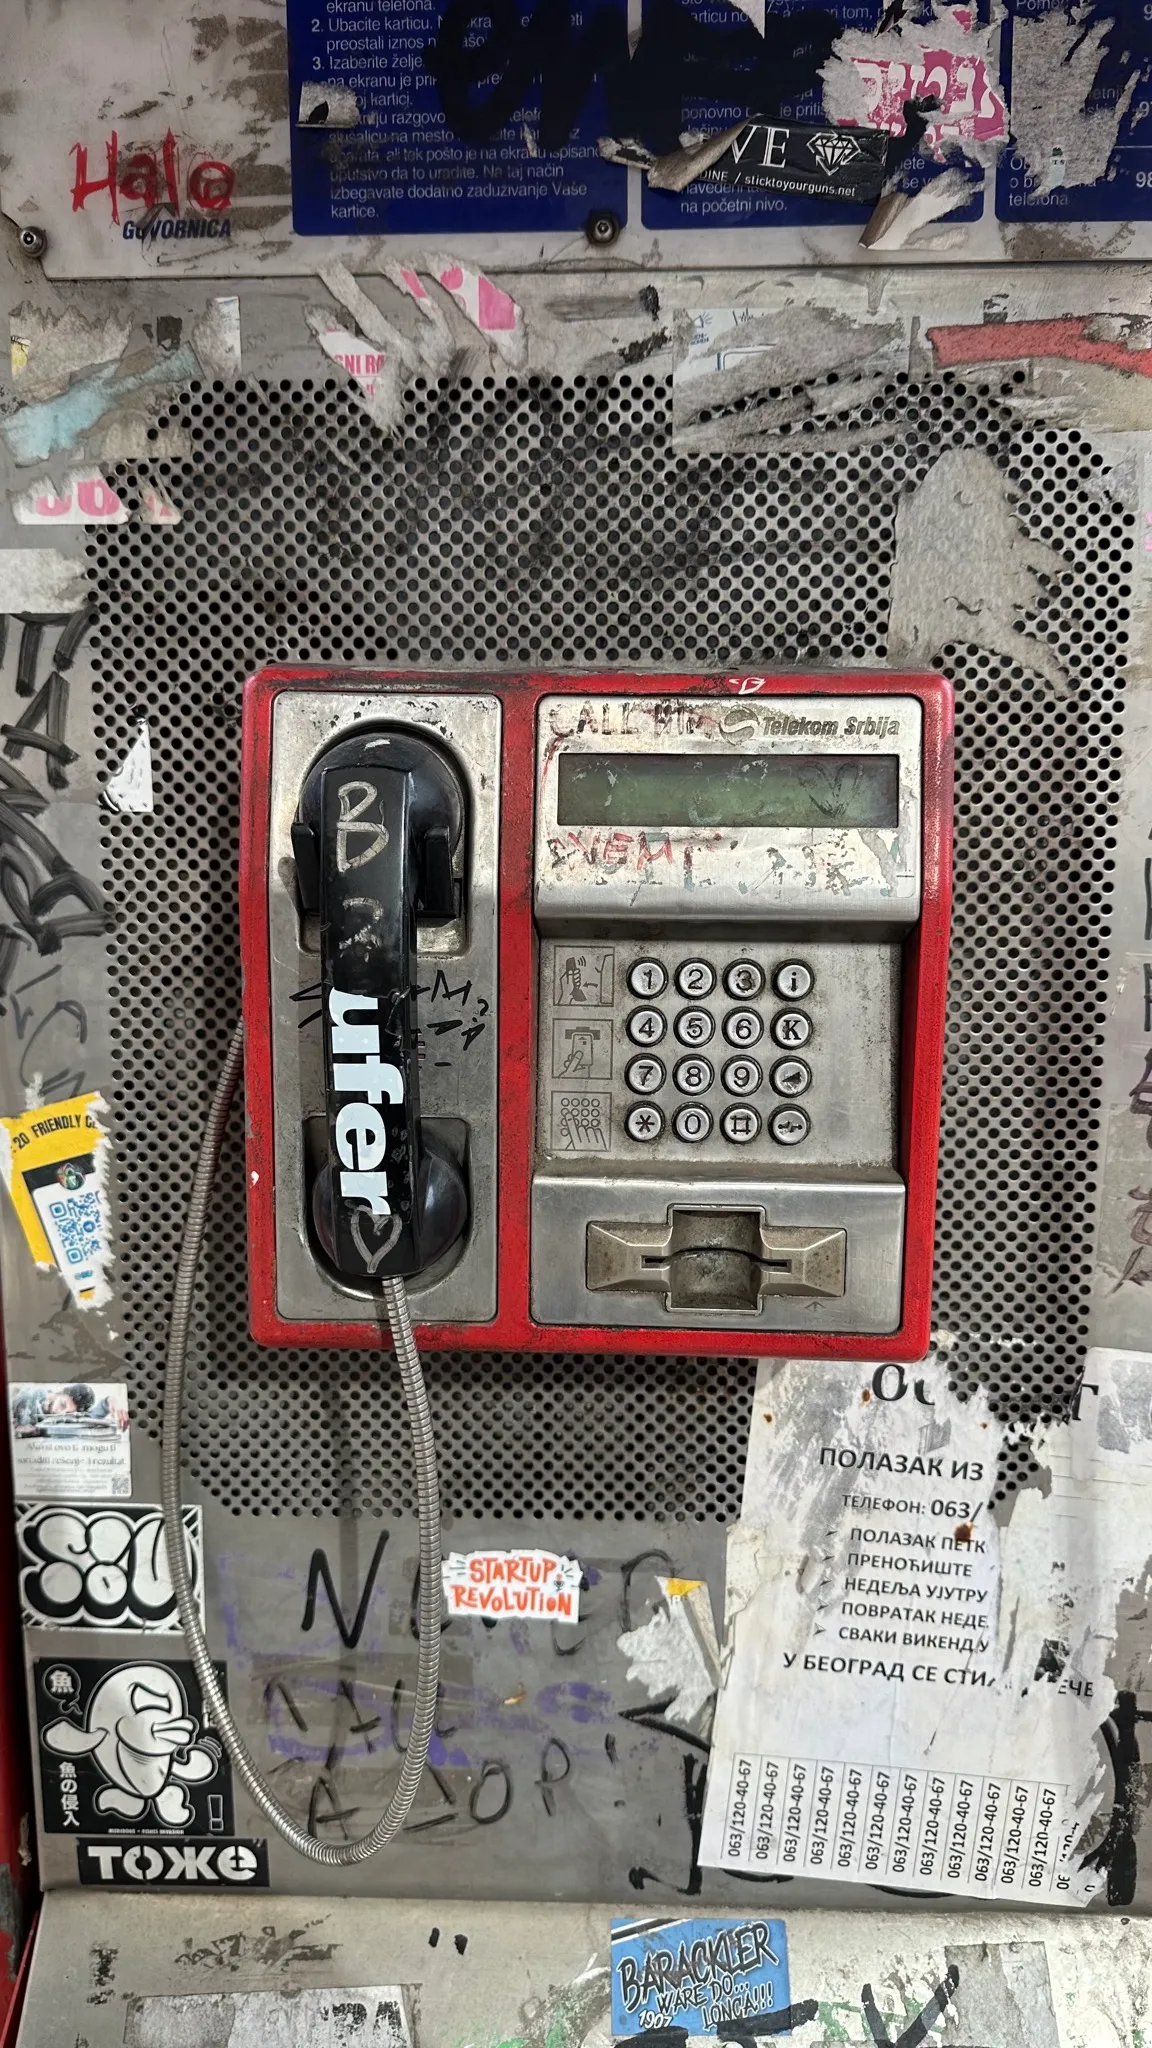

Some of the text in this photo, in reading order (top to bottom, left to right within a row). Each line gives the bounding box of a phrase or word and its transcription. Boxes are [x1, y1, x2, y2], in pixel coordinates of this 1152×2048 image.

[326, 0, 374, 13] ekranu
[311, 18, 324, 33] 2.
[328, 17, 381, 32] Ubacite
[326, 35, 384, 54] preostali
[388, 34, 424, 50] iznos
[312, 56, 325, 71] 3.
[329, 54, 388, 70] Izaberite
[348, 73, 397, 89] ekranu
[399, 72, 412, 91] je
[681, 107, 742, 123] ponovno
[779, 104, 792, 119] je
[412, 128, 455, 144] mesto
[403, 147, 423, 161] tek
[426, 146, 463, 164] pošto
[465, 146, 477, 163] je
[480, 148, 497, 160] na
[391, 166, 409, 181] da
[412, 167, 426, 181] to
[483, 164, 503, 179] Na
[507, 165, 523, 181] taj
[526, 163, 564, 179] način
[330, 184, 404, 202] izbegavate
[407, 183, 464, 199] dodatno
[551, 180, 588, 196] Vaše
[744, 176, 856, 197] sticktoyourguns.net
[331, 203, 379, 219] kartice.
[681, 196, 788, 217] na početni nivo.
[763, 716, 901, 739] Telekom Srbija
[642, 970, 653, 990] 1
[687, 970, 703, 990] 2
[736, 970, 753, 992] 3
[639, 1018, 802, 1041] 4 5 6 K
[638, 1065, 750, 1088] 7 8 9
[31, 1113, 82, 1139] FRIENDLY
[819, 1447, 984, 1481] ПОЛАЗАК ИЗ
[842, 1494, 984, 1523] ТЕЛЕФОН: 063/
[850, 1527, 936, 1549] ПОЛАЗАК
[469, 1556, 557, 1584] STARTUP
[847, 1552, 973, 1577] ПРЕНОЋИШТЕ
[844, 1577, 988, 1603] НЕДЕЉА УЈУТРУ
[841, 1601, 936, 1623] ПОВРАТАК
[838, 1626, 897, 1645] СВАКИ
[902, 1632, 974, 1653] ВИКЕНД
[783, 1652, 797, 1668] У
[803, 1654, 905, 1682] БЕОГРАД
[912, 1665, 938, 1682] СЕ
[50, 1669, 74, 1694] 魚
[58, 1760, 81, 1828] 魚の侵入
[728, 1759, 752, 1857] 063/120-40-67
[755, 1761, 779, 1860] 063/120-40-67
[783, 1764, 807, 1862] 063/120-40-67
[810, 1766, 834, 1865] 063/120-40-67
[838, 1768, 862, 1868] 063/120-40-67
[865, 1771, 891, 1870] 063/120-40-67
[893, 1773, 918, 1873] 063/120-40-67
[919, 1776, 946, 1876] 063/120-40-67
[947, 1779, 974, 1879] 063/120-40-67
[974, 1782, 1001, 1882] 063/120-40-67
[1001, 1785, 1029, 1884] 063/120-40-67
[1029, 1788, 1056, 1887] 063/120-40-67
[617, 1920, 780, 2014] BARACKLER
[638, 2010, 673, 2030] 1907
